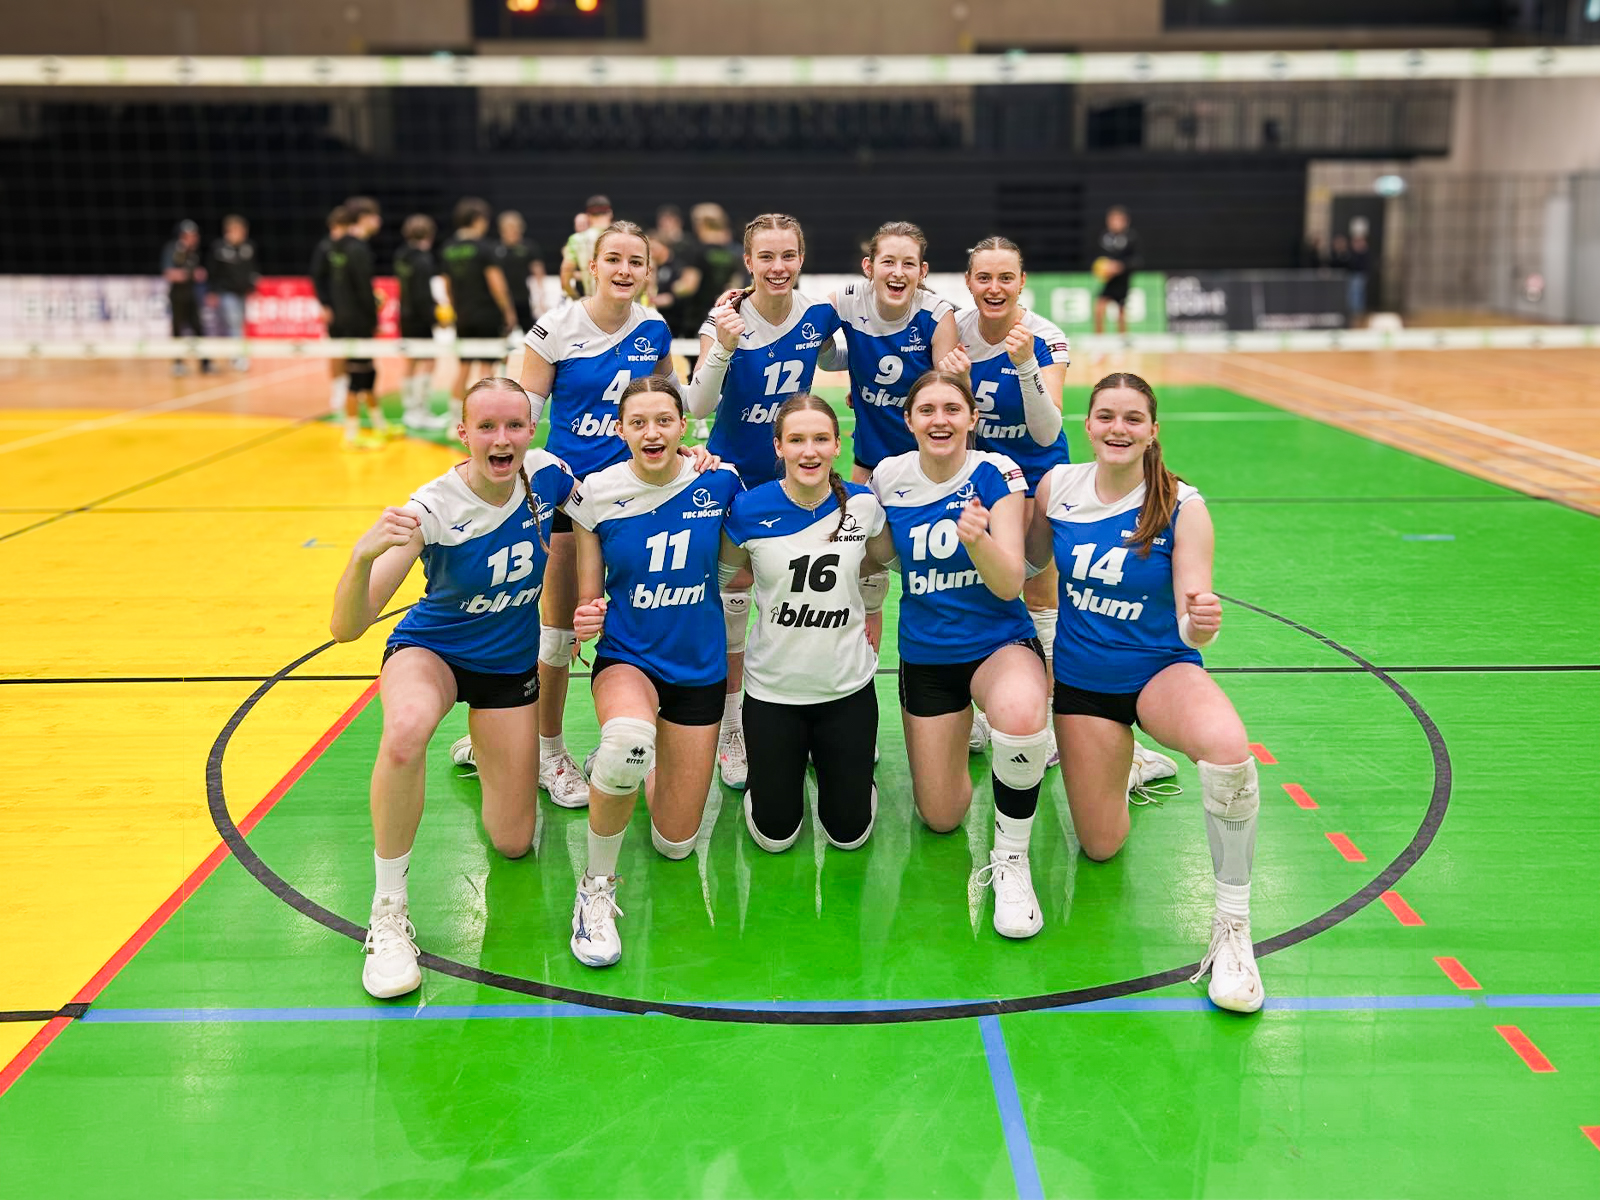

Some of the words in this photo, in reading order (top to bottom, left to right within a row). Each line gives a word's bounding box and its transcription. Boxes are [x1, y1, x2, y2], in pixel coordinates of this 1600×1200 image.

[602, 370, 631, 404] 4
[763, 360, 804, 396] 12
[874, 355, 903, 385] 9
[975, 380, 999, 412] 5
[978, 419, 1026, 439] lum
[683, 511, 697, 519] VBC
[697, 508, 723, 518] HÖCHST
[646, 529, 691, 572] 11
[909, 519, 959, 561] 10
[488, 541, 534, 587] 13
[789, 553, 840, 593] 16
[1071, 543, 1129, 586] 14
[465, 584, 542, 614] blum
[632, 582, 705, 609] blum
[1066, 582, 1144, 621] blum
[777, 602, 849, 628] blum
